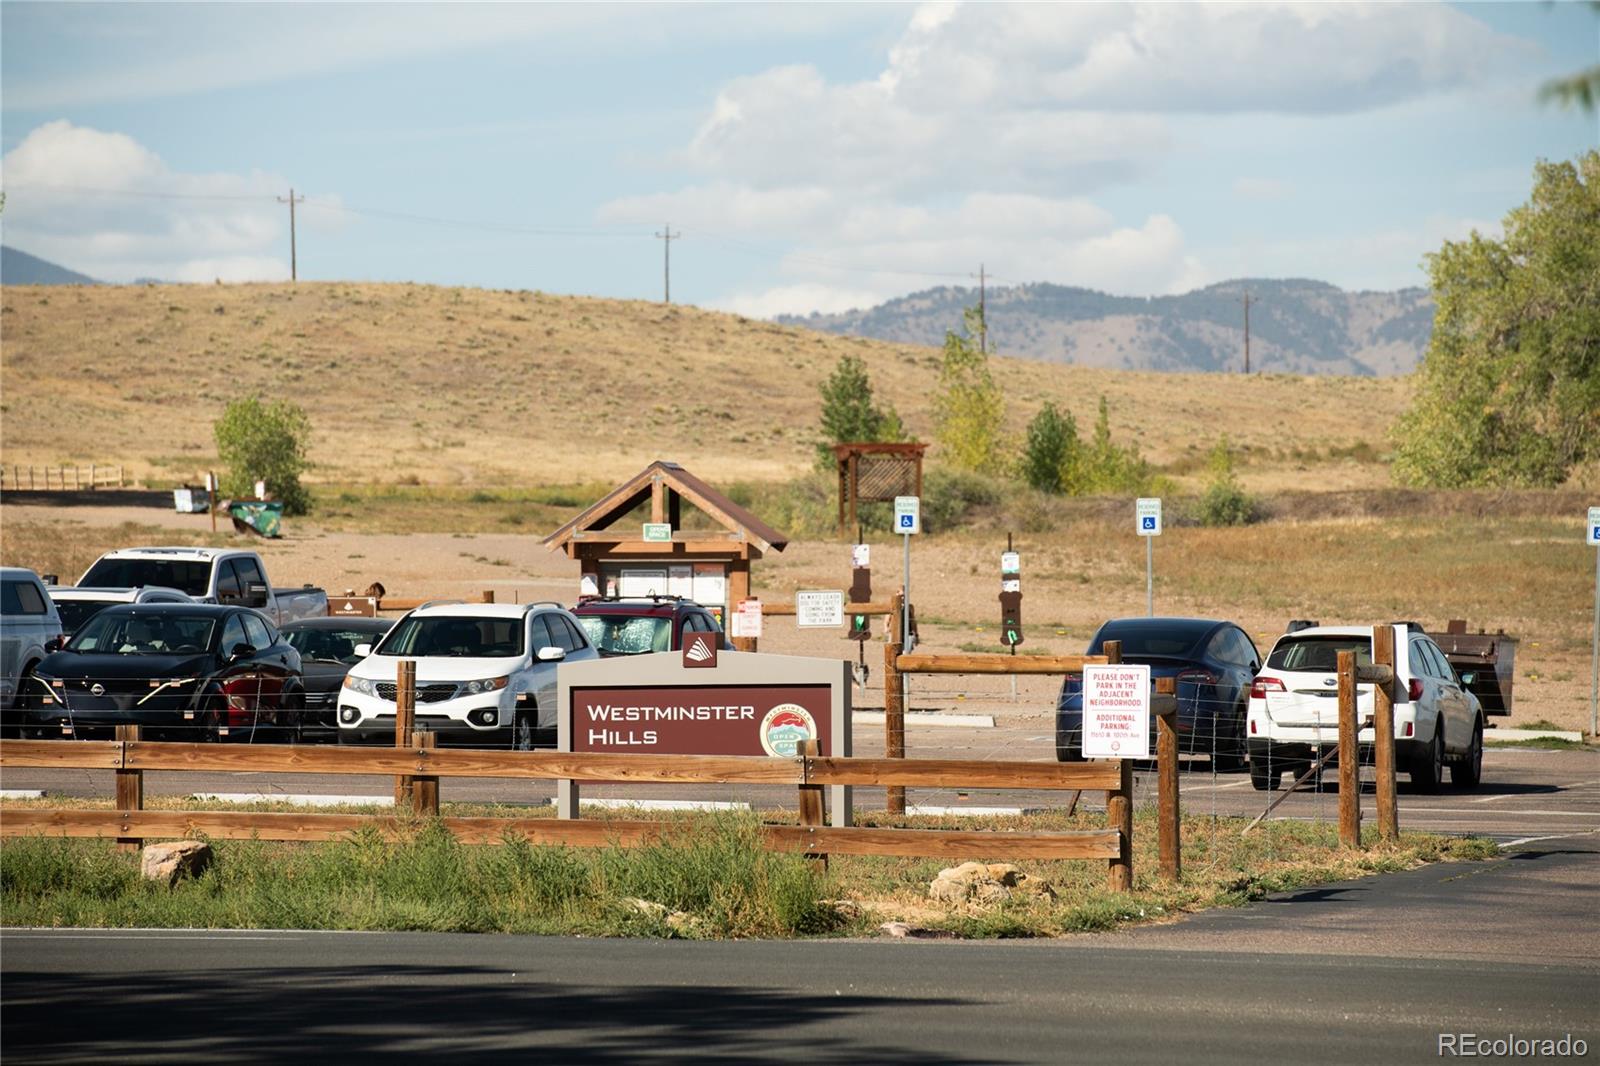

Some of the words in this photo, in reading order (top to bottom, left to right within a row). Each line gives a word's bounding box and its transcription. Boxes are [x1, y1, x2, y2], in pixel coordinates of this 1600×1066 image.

[1093, 673, 1118, 681] PLEASE
[1120, 673, 1140, 681] DON'T
[1125, 682, 1137, 690] THE
[1099, 690, 1134, 698] ADJACENT
[587, 705, 755, 721] WESTMINSTER
[1096, 714, 1136, 722] ADDITIONAL
[588, 728, 658, 745] HILLS
